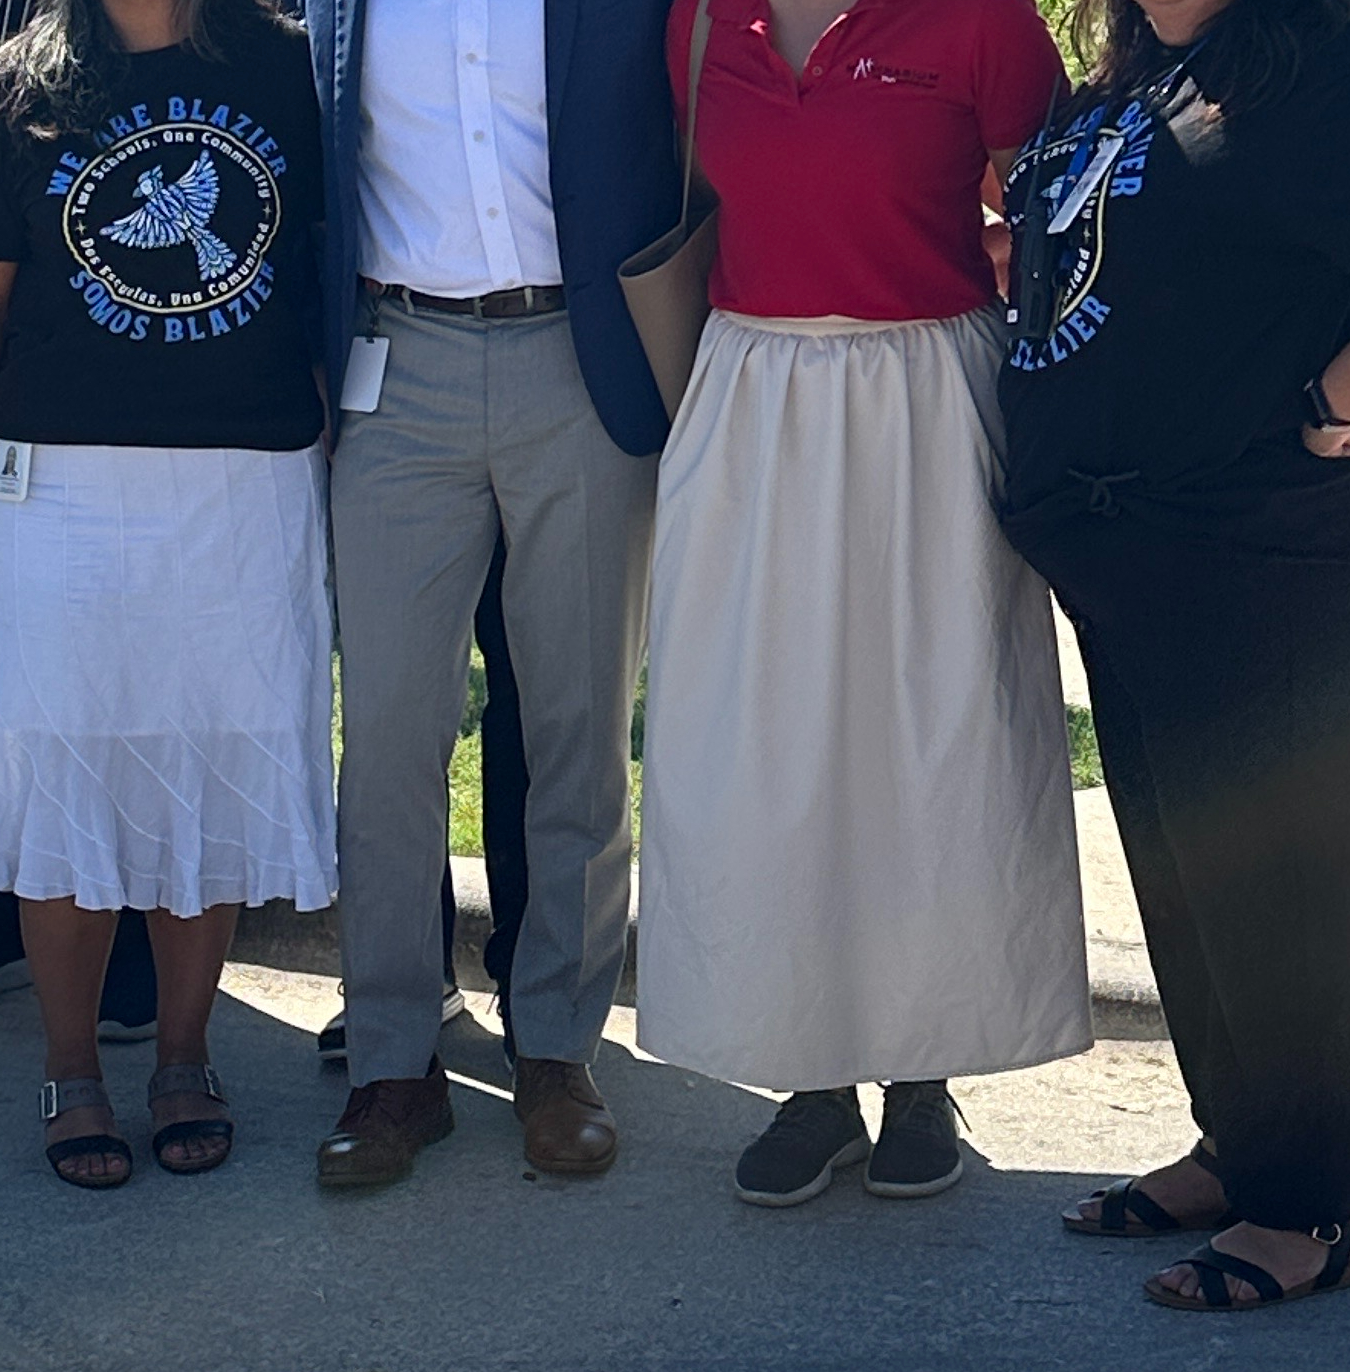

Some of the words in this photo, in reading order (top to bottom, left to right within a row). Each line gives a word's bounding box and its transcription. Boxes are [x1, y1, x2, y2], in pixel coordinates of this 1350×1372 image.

[45, 149, 88, 195] WE
[93, 103, 154, 147] ARE
[167, 95, 288, 178] BLAZIER
[68, 269, 151, 340] SOMOS
[164, 260, 275, 343] BLAZIER
